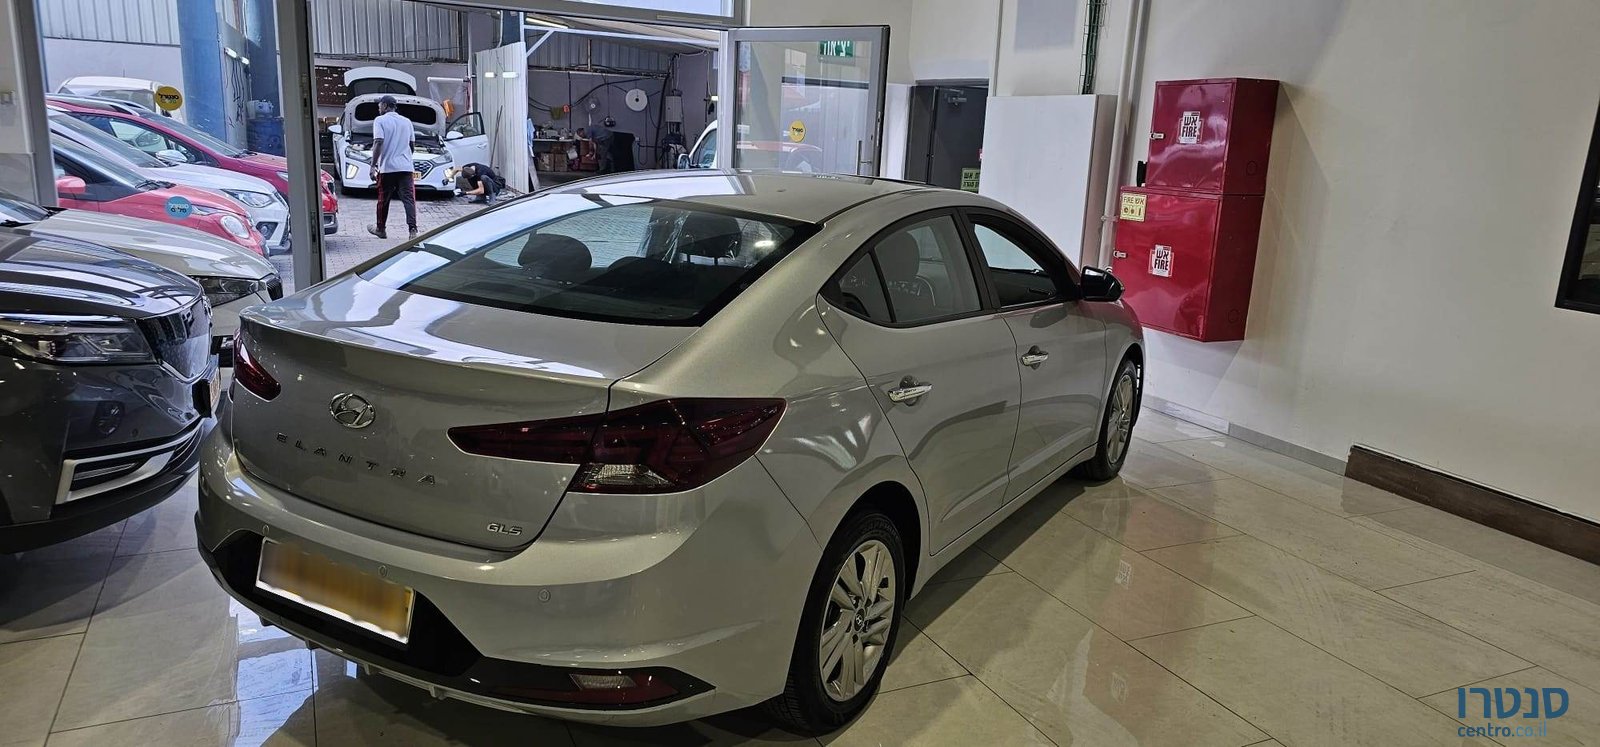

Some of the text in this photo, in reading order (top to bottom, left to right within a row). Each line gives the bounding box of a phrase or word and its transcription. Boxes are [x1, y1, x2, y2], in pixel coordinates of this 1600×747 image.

[1184, 116, 1198, 126] אש
[1181, 126, 1197, 137] FIRE
[1123, 196, 1134, 204] FIRE
[1156, 249, 1169, 259] אש
[1154, 259, 1169, 270] FIRE
[277, 432, 436, 485] ELANTRA
[486, 522, 523, 537] GLS
